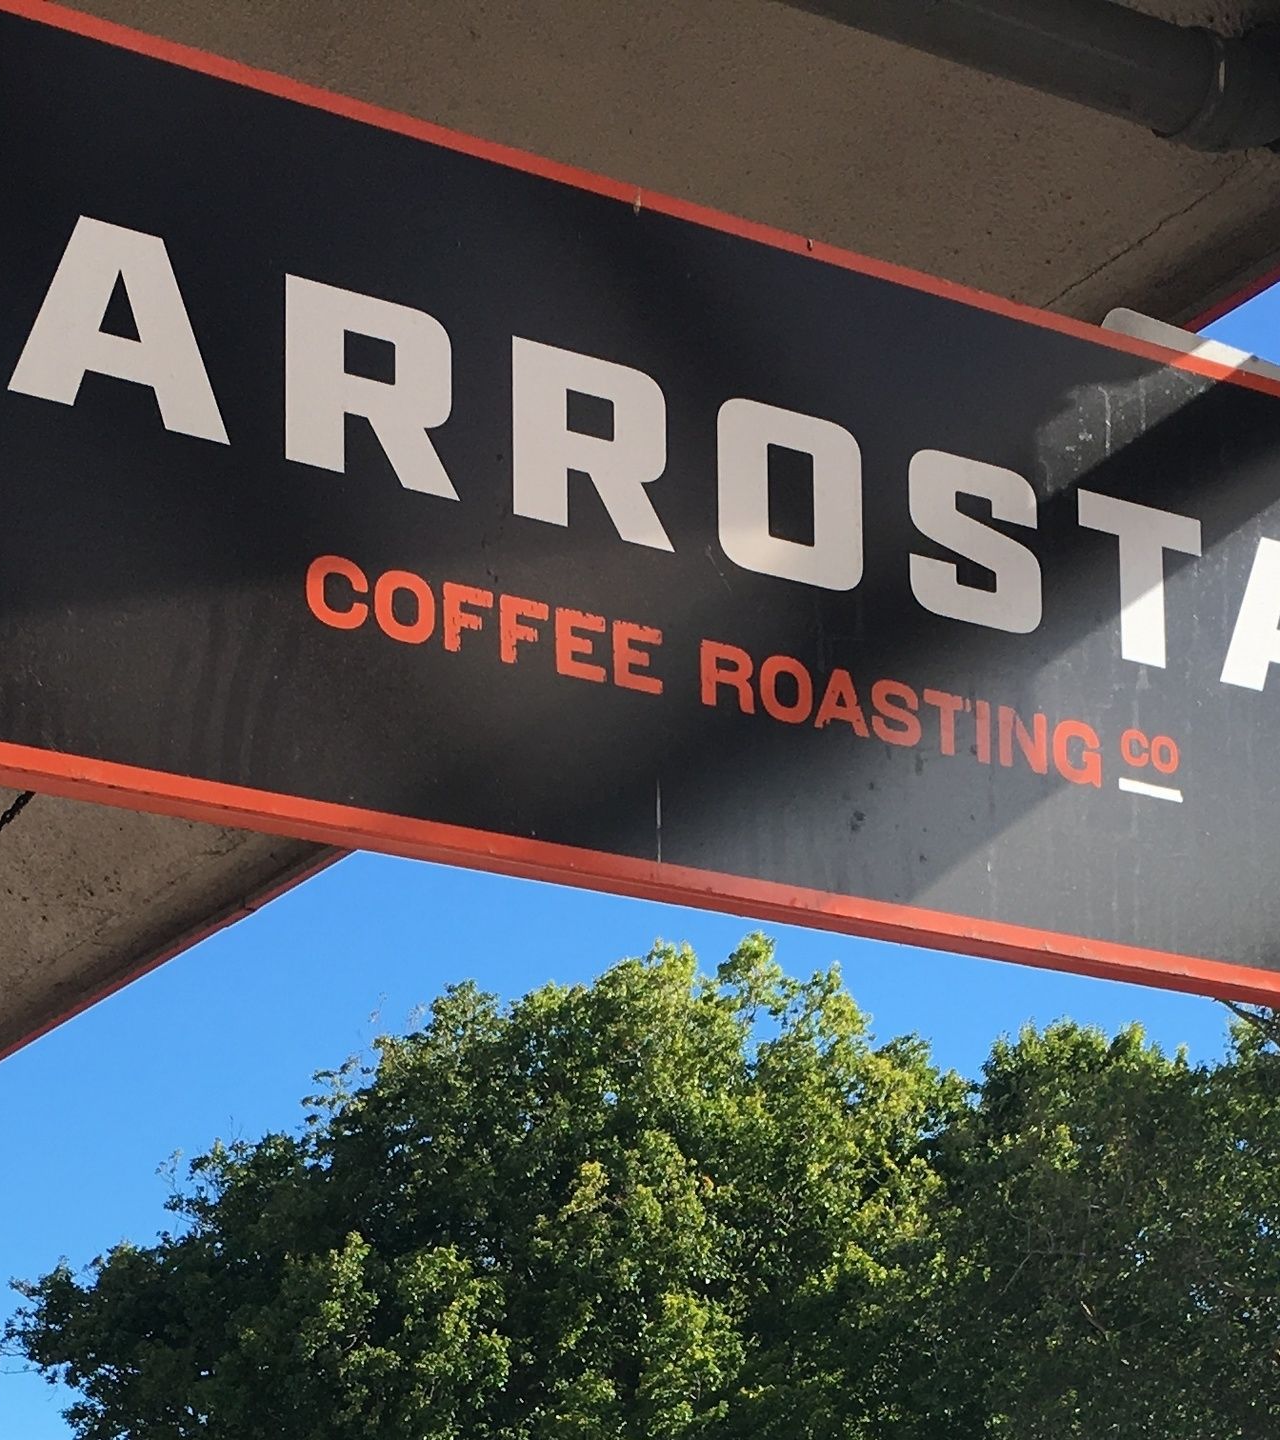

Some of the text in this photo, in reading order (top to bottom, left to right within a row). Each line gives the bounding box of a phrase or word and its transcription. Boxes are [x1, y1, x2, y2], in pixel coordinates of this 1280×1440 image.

[305, 555, 1179, 788] COFFEE ROASTING CO
